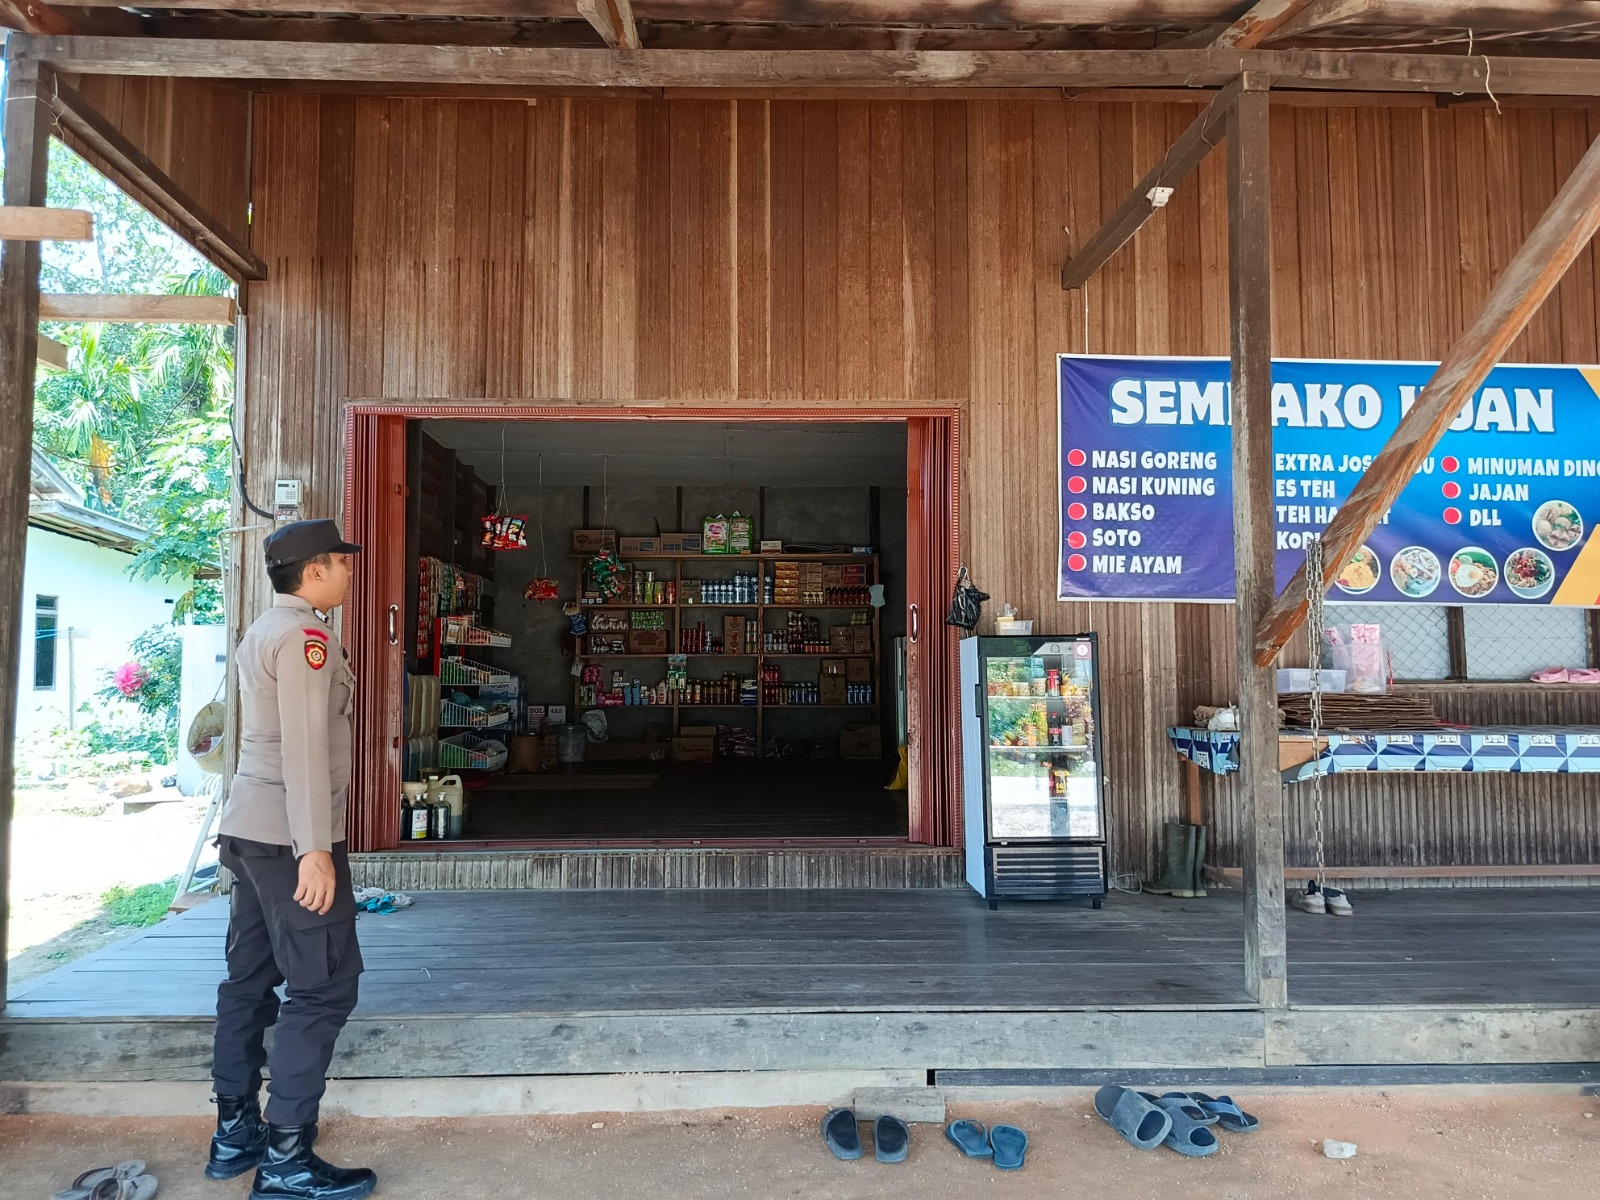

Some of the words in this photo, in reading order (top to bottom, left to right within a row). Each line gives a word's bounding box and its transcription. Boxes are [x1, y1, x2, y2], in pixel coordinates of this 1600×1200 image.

[1111, 379, 1382, 429] SEMAKO
[1092, 450, 1137, 469] NASI
[1141, 451, 1217, 470] GORENG
[1275, 453, 1334, 472] EXTRA
[1338, 454, 1377, 473] JOS
[1468, 457, 1560, 477] MINUMAN
[1092, 476, 1137, 495] NASI
[1141, 477, 1216, 496] KUNING
[1275, 479, 1297, 497] ES
[1300, 480, 1336, 498] TEH
[1468, 483, 1529, 501] JAJAN
[1092, 502, 1155, 521] BAKSO
[1276, 505, 1311, 524] TEH
[1469, 508, 1502, 527] DLL
[1092, 528, 1141, 547] SOTO
[1092, 555, 1126, 573] MIE
[1130, 555, 1183, 575] AYAM
